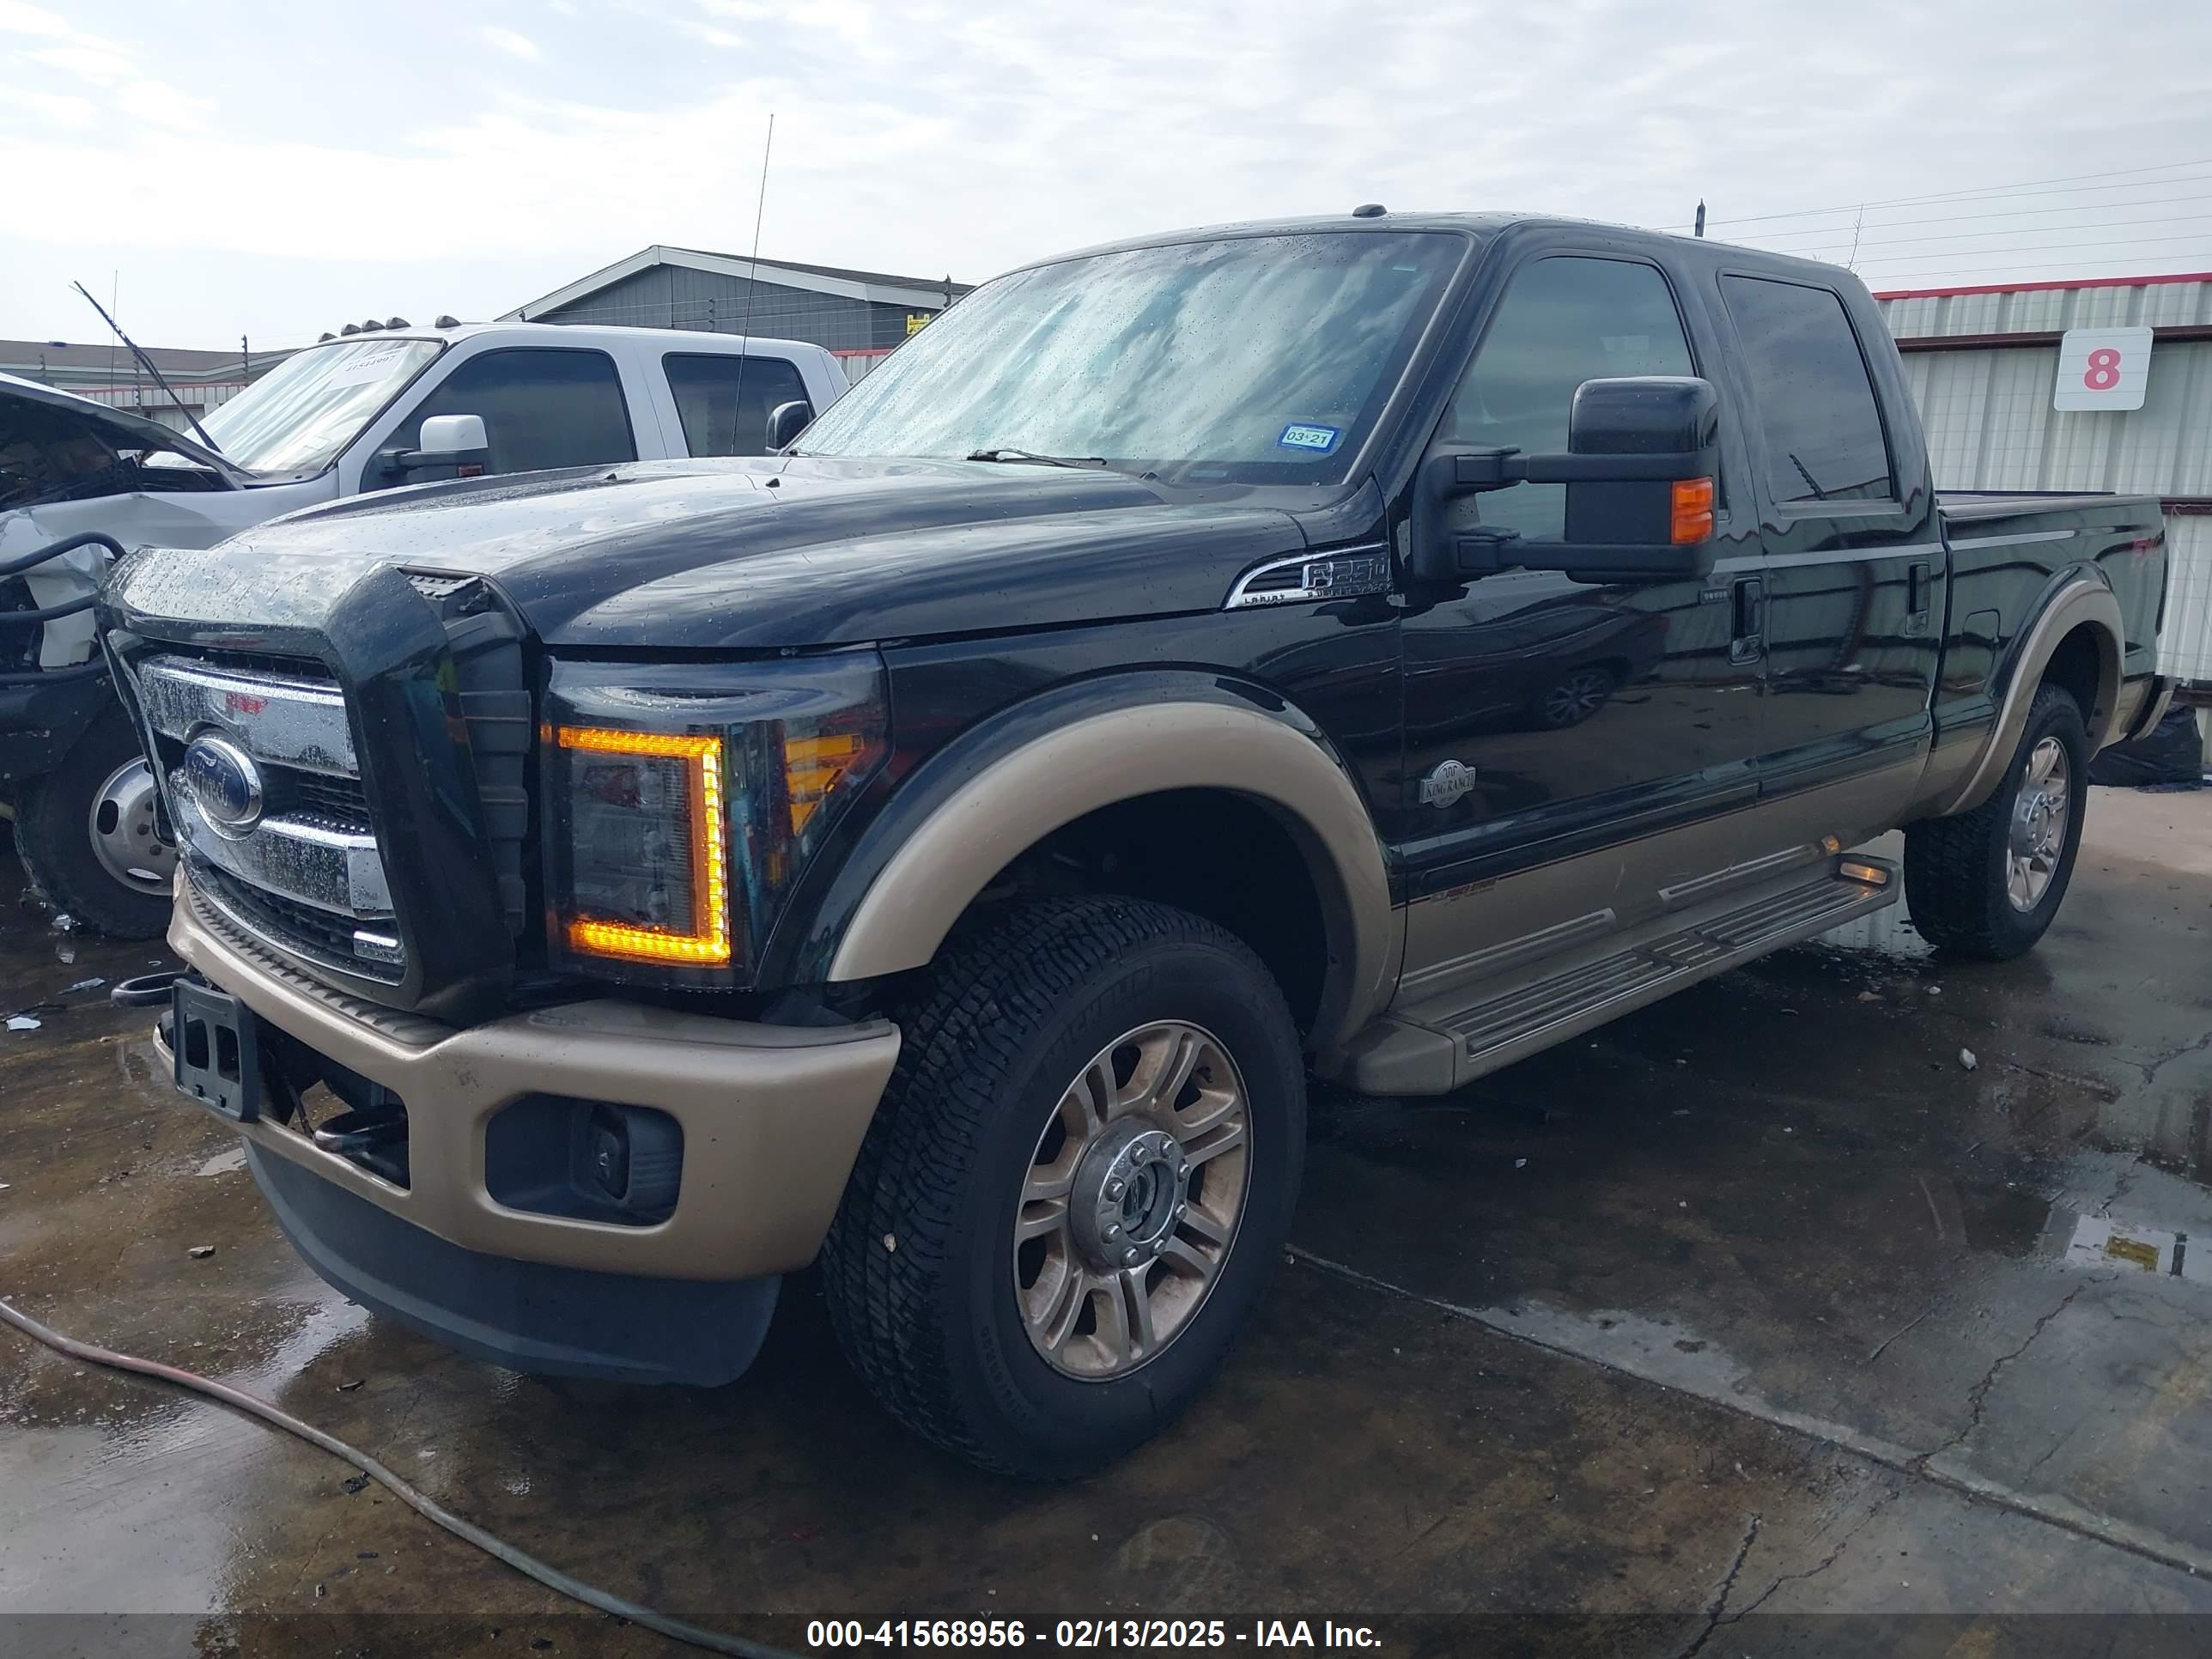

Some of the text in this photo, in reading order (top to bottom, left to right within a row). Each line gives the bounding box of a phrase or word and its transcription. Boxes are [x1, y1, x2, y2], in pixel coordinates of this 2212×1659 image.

[2084, 348, 2121, 391] 8
[1286, 431, 1328, 444] 03 21
[1244, 593, 1285, 605] LARIAT
[191, 750, 229, 806] Ford
[1426, 781, 1446, 799] KING
